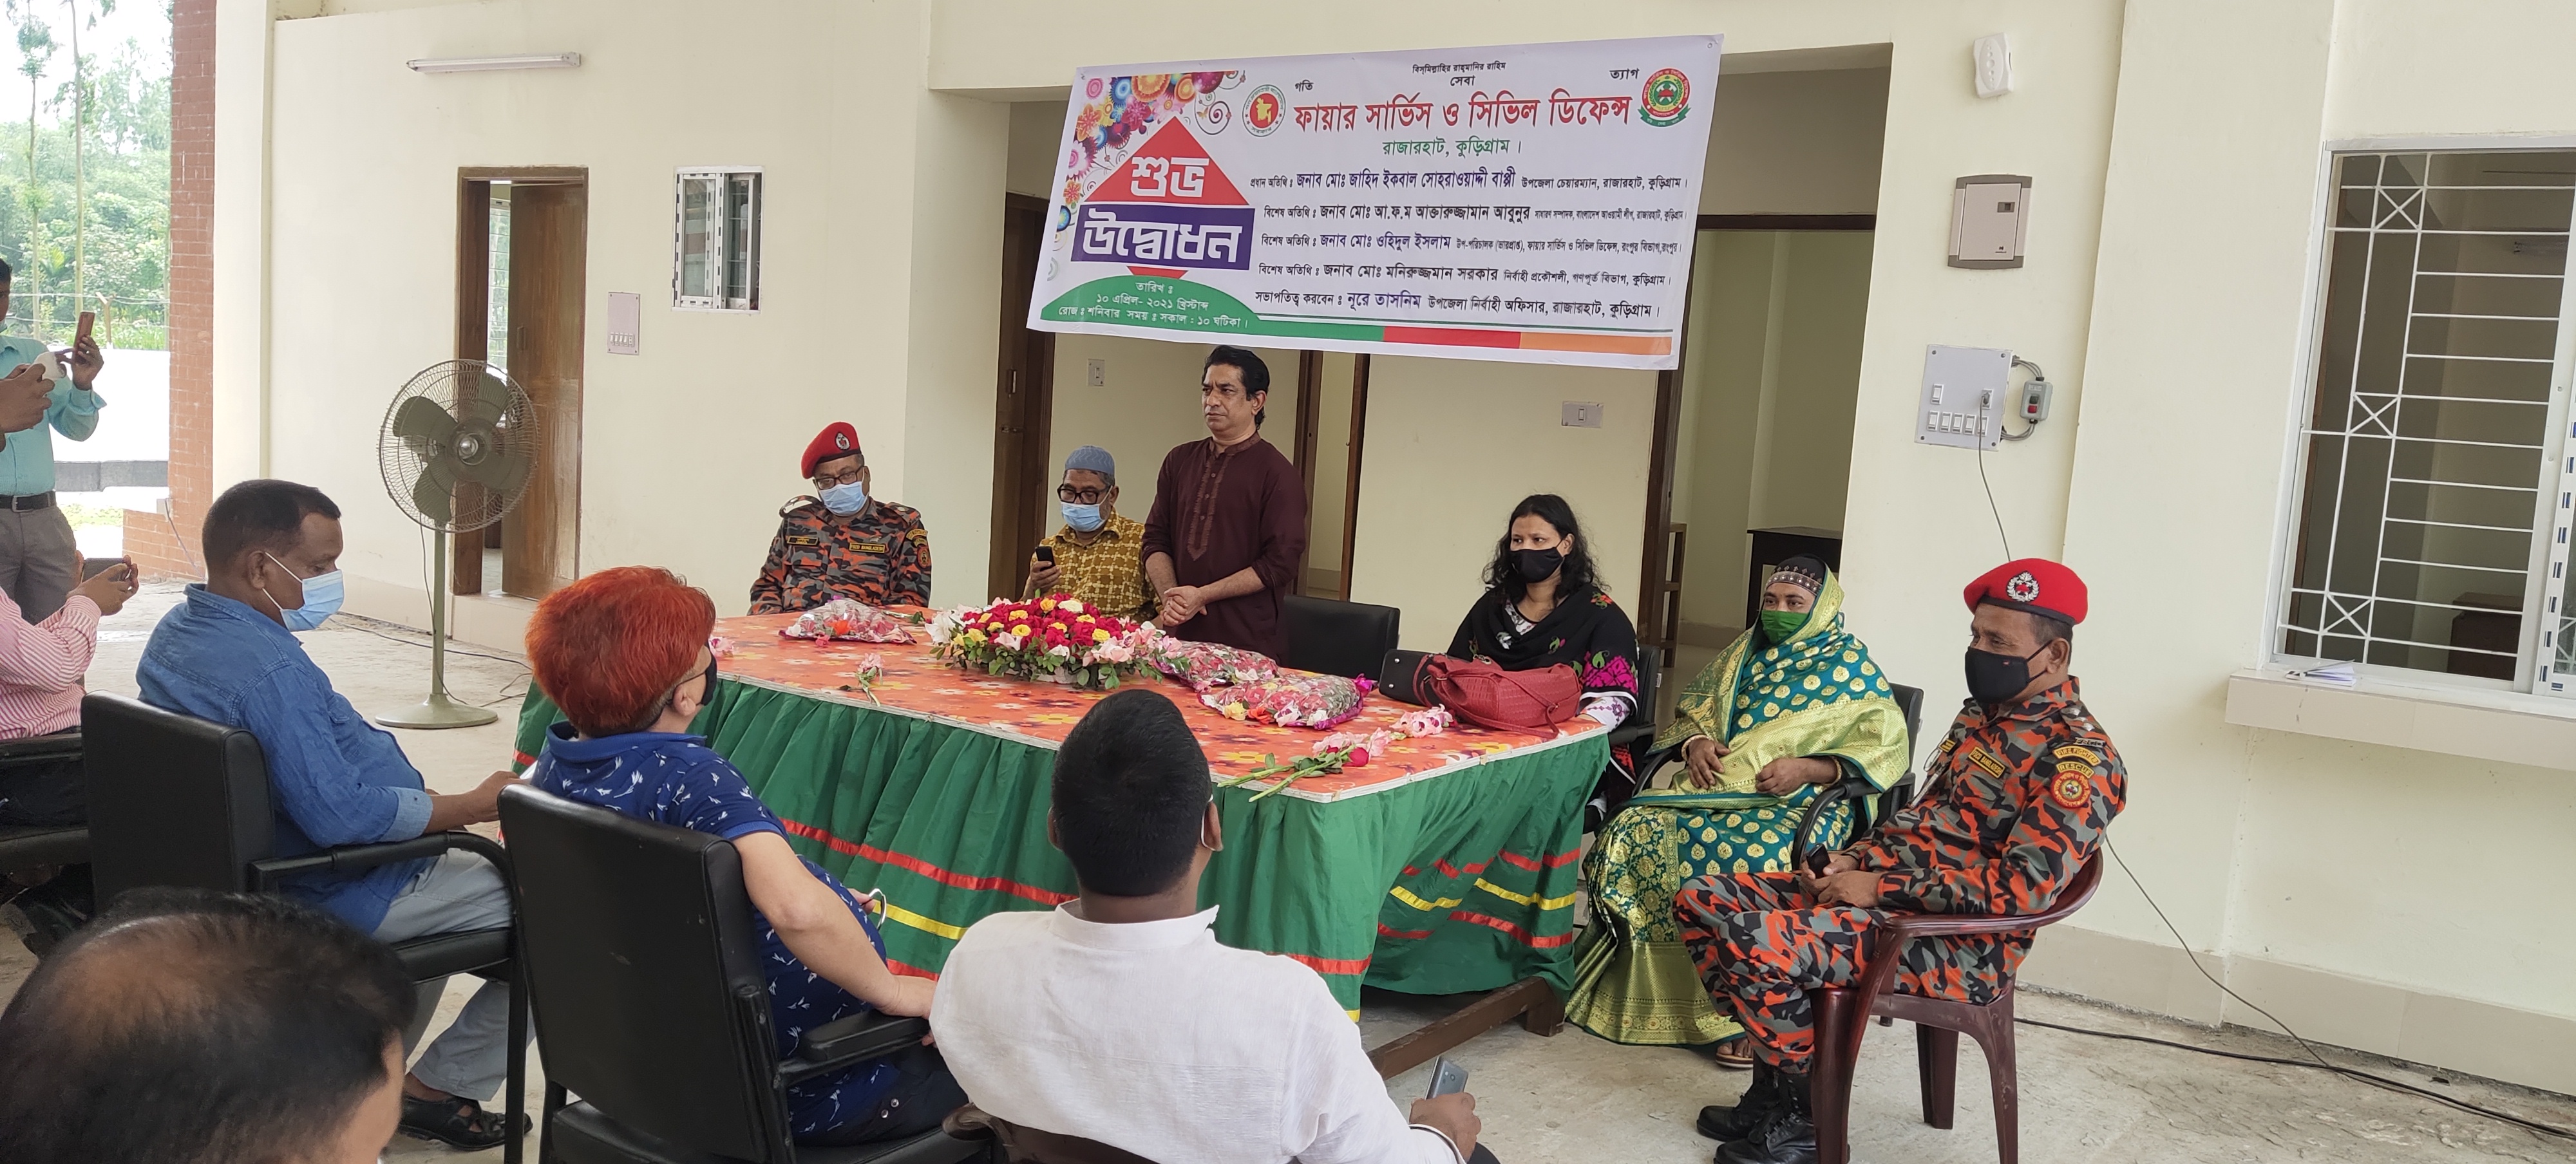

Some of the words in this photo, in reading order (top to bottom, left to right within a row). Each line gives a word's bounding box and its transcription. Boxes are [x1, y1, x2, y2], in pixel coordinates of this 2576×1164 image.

[1486, 61, 1506, 70] রাহিম
[1294, 79, 1314, 92] গতি
[1450, 75, 1475, 86] সেবা
[1609, 68, 1640, 80] ত্যাগ
[1293, 102, 1358, 133] ফায়ার
[1365, 91, 1434, 131] সার্ভিস
[1442, 102, 1459, 127] ও
[1468, 89, 1541, 128] সিভিল
[1549, 88, 1633, 127] ডিফেন্স
[1382, 136, 1449, 157] রাজারহাট,
[1455, 135, 1511, 159] কুড়িগ্রাম
[1130, 156, 1209, 198] শুভ
[1250, 178, 1266, 189] প্রধান
[1268, 175, 1288, 188] অতিথি
[1296, 171, 1322, 189] জনাব
[1325, 171, 1346, 189] মোঃ
[1349, 168, 1379, 190] জাহিদ
[1383, 167, 1418, 190] ইকবাল
[1492, 165, 1516, 188] বাপ্পী
[1522, 176, 1554, 189] উপজেলা
[1557, 178, 1600, 191] চেয়ারম্যান,
[1603, 176, 1644, 191] রাজারহাট,
[1648, 175, 1681, 191] কুড়িগ্রাম
[1264, 205, 1285, 218] বিশেষ
[1288, 205, 1310, 218] অতিথি
[1320, 204, 1347, 219] জনাব
[1350, 203, 1371, 219] মোঃ
[1374, 203, 1412, 220] আ.ফ.ম
[1493, 204, 1531, 223] আবুনুর
[1082, 207, 1243, 263] উদ্বোধন
[1261, 233, 1283, 246] বিশেষ
[1285, 234, 1310, 247] অতিথি
[1320, 233, 1347, 248] জনাব
[1350, 234, 1372, 248] মোঃ
[1376, 232, 1410, 252] ওহিদুল
[1414, 232, 1451, 250] ইসলাম
[1528, 241, 1546, 251] ফায়ার
[1547, 238, 1566, 251] সার্ভিস
[1568, 242, 1573, 250] ও
[1576, 239, 1595, 252] সিভিল
[1622, 243, 1639, 254] রংপুর
[1258, 263, 1283, 275] বিশেষ
[1285, 263, 1312, 276] অতিথি
[1323, 263, 1354, 277] জনাব
[1358, 265, 1382, 278] মোঃ
[1457, 267, 1499, 281] সরকার
[1504, 269, 1529, 283] নির্বাহী
[1531, 270, 1569, 285] প্রকৌশলী,
[1573, 271, 1600, 286] গণপূর্ত
[1602, 272, 1629, 286] বিভাগ,
[1633, 272, 1665, 287] কুড়িগ্রাম
[1135, 281, 1164, 294] তারিখ
[1096, 294, 1109, 303] ১০
[1146, 297, 1173, 309] ২০২১
[1255, 289, 1300, 307] সভাপতিত্ব
[1303, 294, 1334, 306] করবেন
[1347, 292, 1370, 311] নূরে
[1374, 290, 1422, 309] তাসনিম
[1428, 294, 1468, 310] উপজেলা
[1470, 295, 1501, 313] নির্বাহী
[1504, 297, 1548, 316] অফিসার,
[1552, 299, 1605, 318] রাজারহাট,
[1609, 300, 1652, 320] কুড়িগ্রাম
[1058, 306, 1078, 315] রোজ
[1087, 305, 1121, 318] শনিবার
[1126, 310, 1149, 321] সময়
[1160, 313, 1187, 324] সকাল
[1197, 316, 1210, 325] ১০
[1213, 314, 1241, 328] ঘটিকা
[2059, 764, 2092, 776] RESCUE
